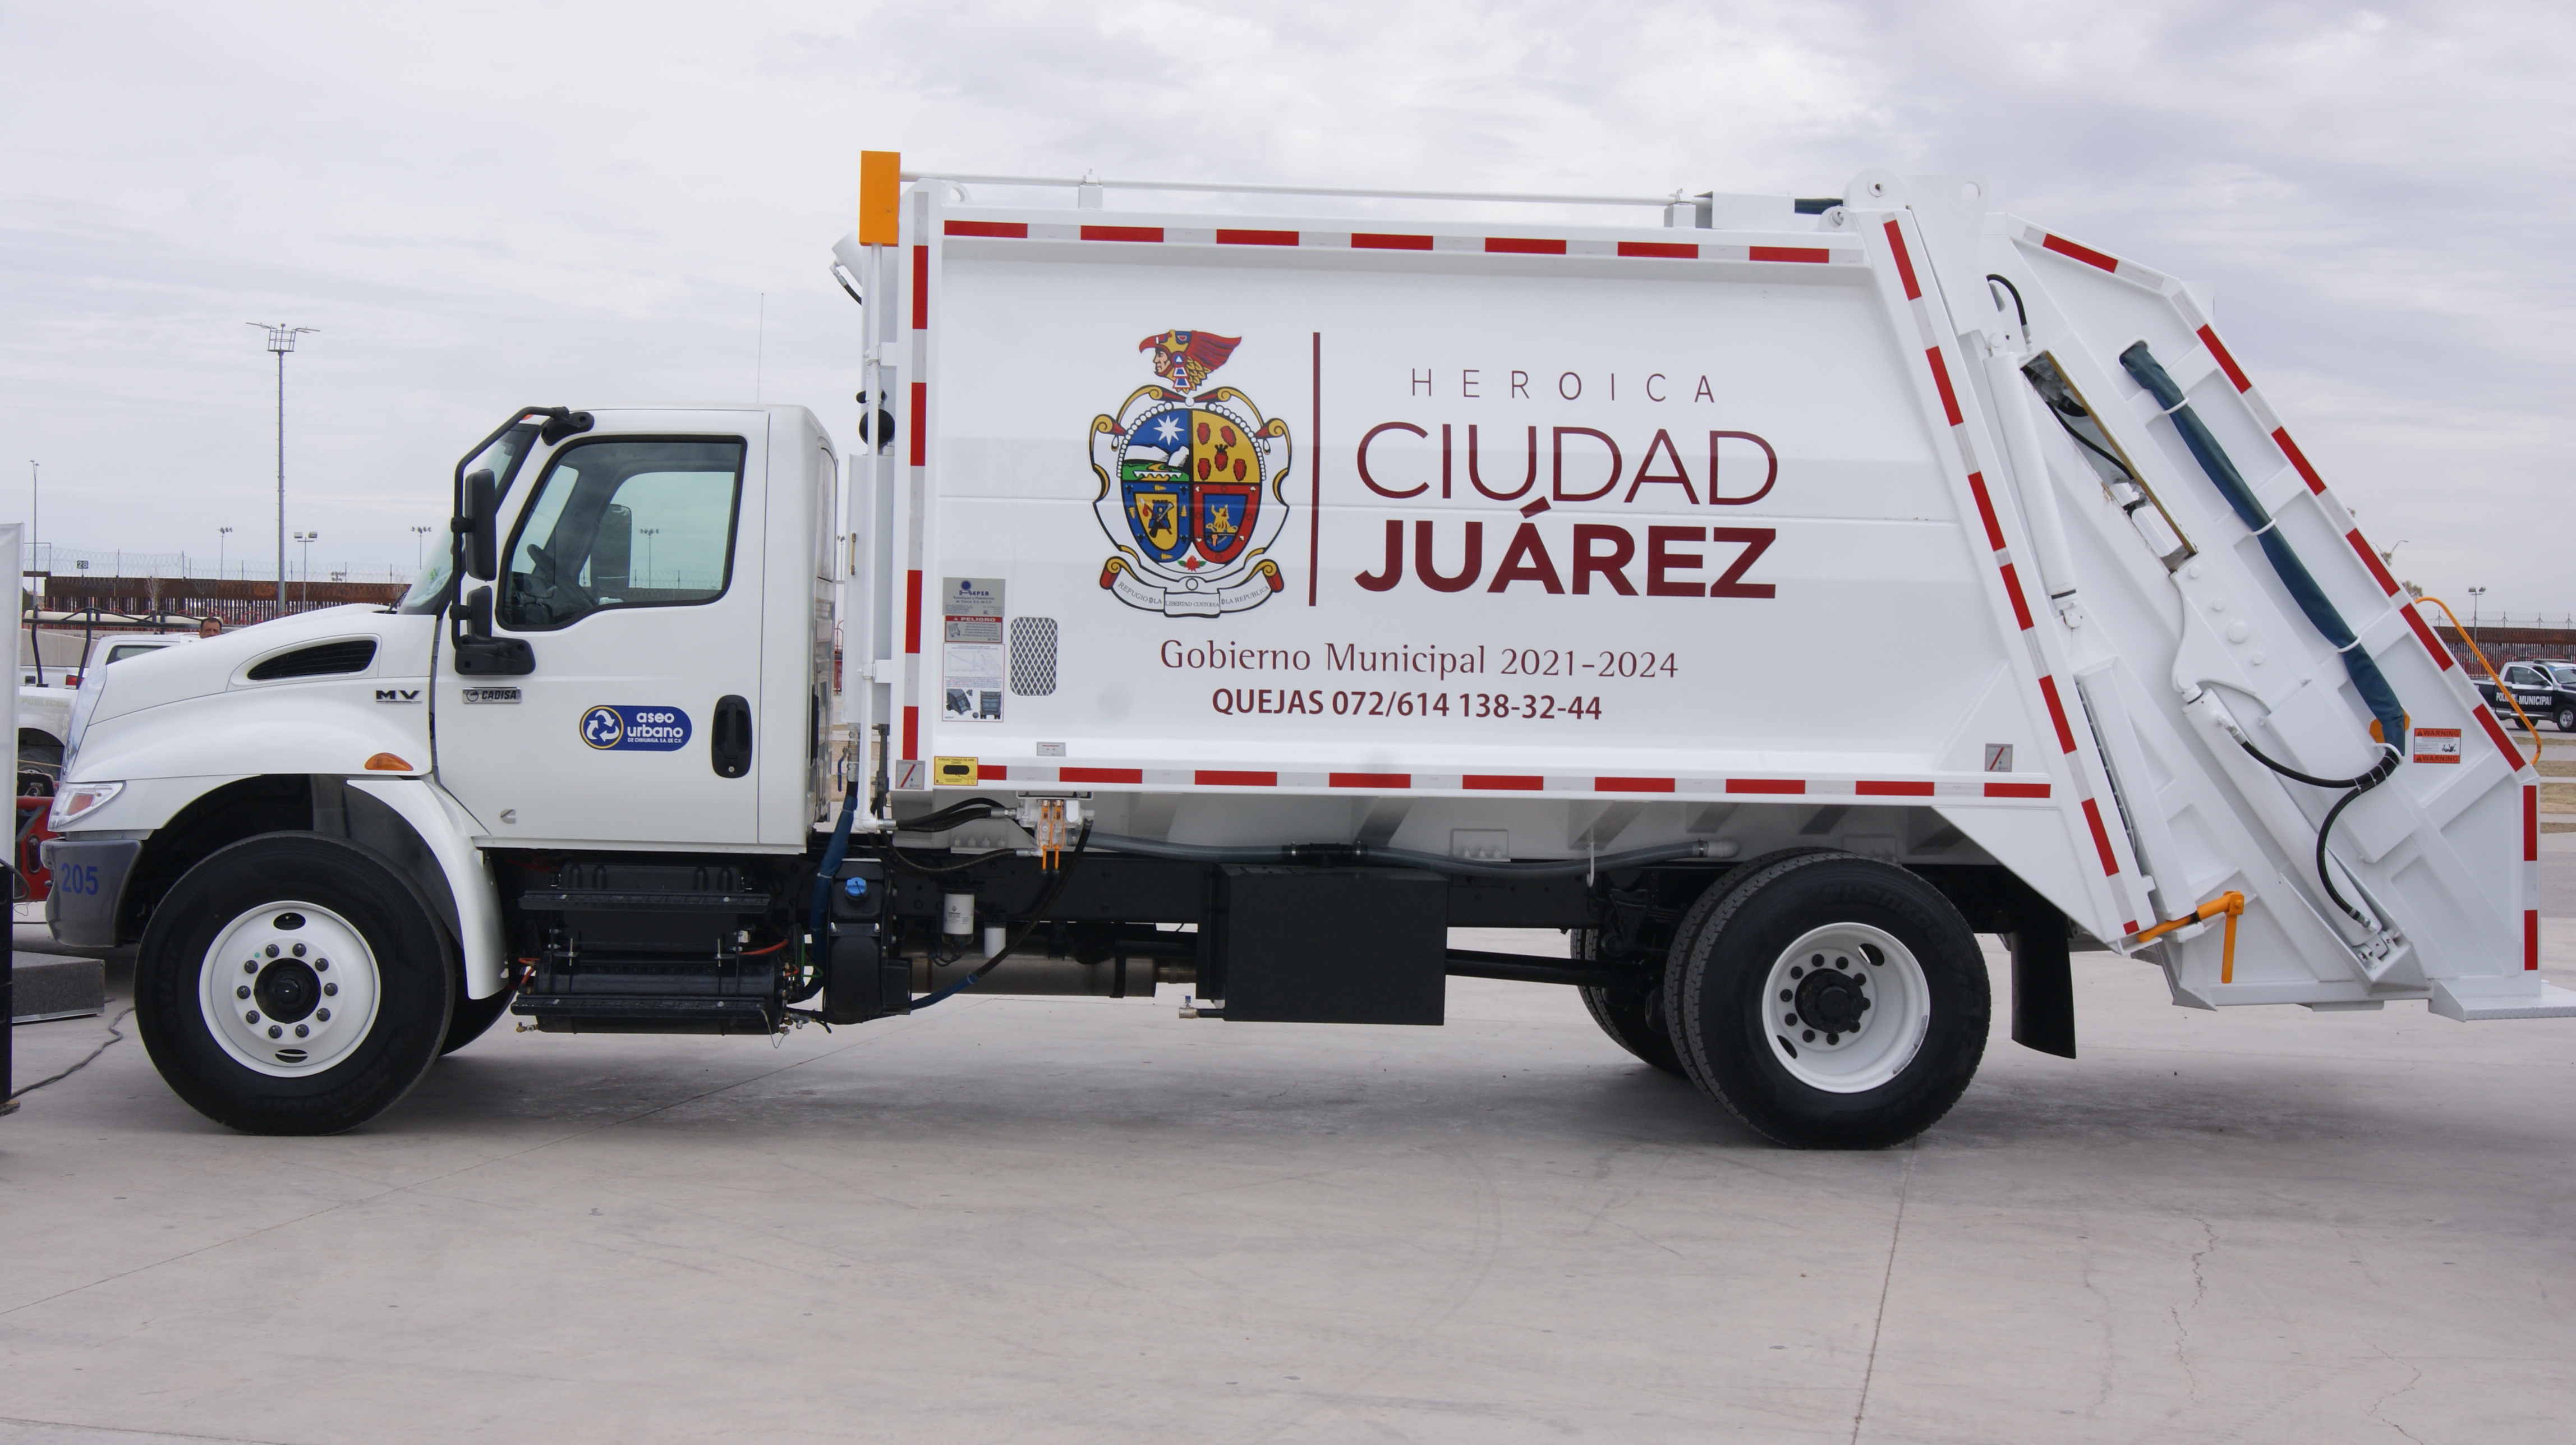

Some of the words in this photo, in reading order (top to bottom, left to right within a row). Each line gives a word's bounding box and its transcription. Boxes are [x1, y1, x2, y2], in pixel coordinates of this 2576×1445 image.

[1412, 368, 1714, 403] HEROICA
[1357, 421, 1778, 505] CIUDAD
[1354, 496, 1777, 599] JUÁREZ
[1118, 582, 1148, 602] REFUGIO
[1235, 586, 1270, 603] REPUBLICA
[1161, 639, 1310, 670] Gobierno
[1325, 643, 1484, 681] Municipal
[1502, 648, 1678, 678] 2021-2024
[376, 690, 420, 700] MV
[481, 691, 516, 700] CADISA
[1212, 688, 1324, 717] QUEJAS
[1332, 691, 1449, 718] 072/614
[1460, 694, 1602, 720] 138-32-44
[636, 712, 675, 723] aseo
[627, 724, 684, 738] urbano
[61, 863, 99, 896] 205
